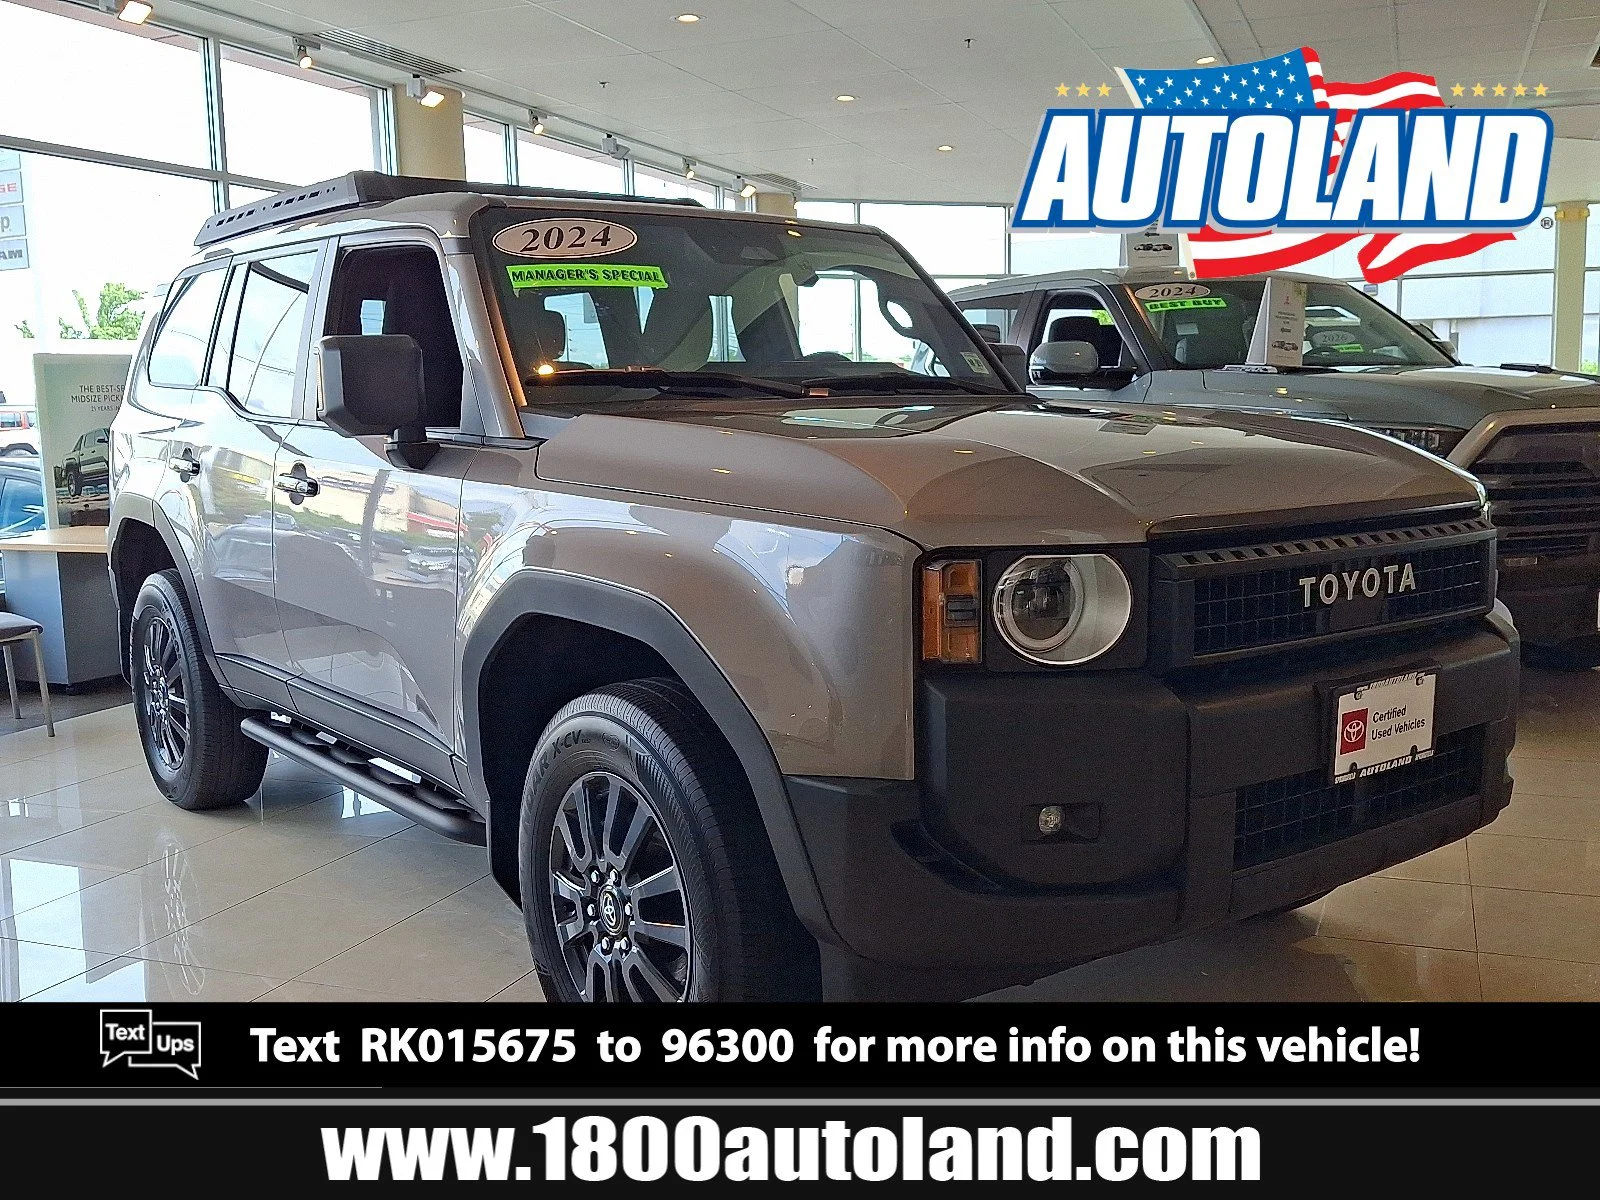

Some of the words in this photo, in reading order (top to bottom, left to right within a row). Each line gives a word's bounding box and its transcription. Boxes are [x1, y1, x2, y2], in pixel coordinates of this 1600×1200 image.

[520, 225, 611, 252] 2024
[511, 268, 598, 283] MANAGER'S
[602, 270, 662, 283] SPECIAL
[1148, 286, 1197, 298] 2024
[1149, 301, 1187, 309] BEST
[80, 384, 94, 393] THE
[71, 395, 102, 403] MIDSIZE
[1299, 563, 1416, 608] TOYOTA
[1373, 704, 1407, 723] Certified
[1371, 727, 1392, 740] Used
[1394, 717, 1426, 734] Vehicles
[1359, 755, 1412, 778] AUTOLAND
